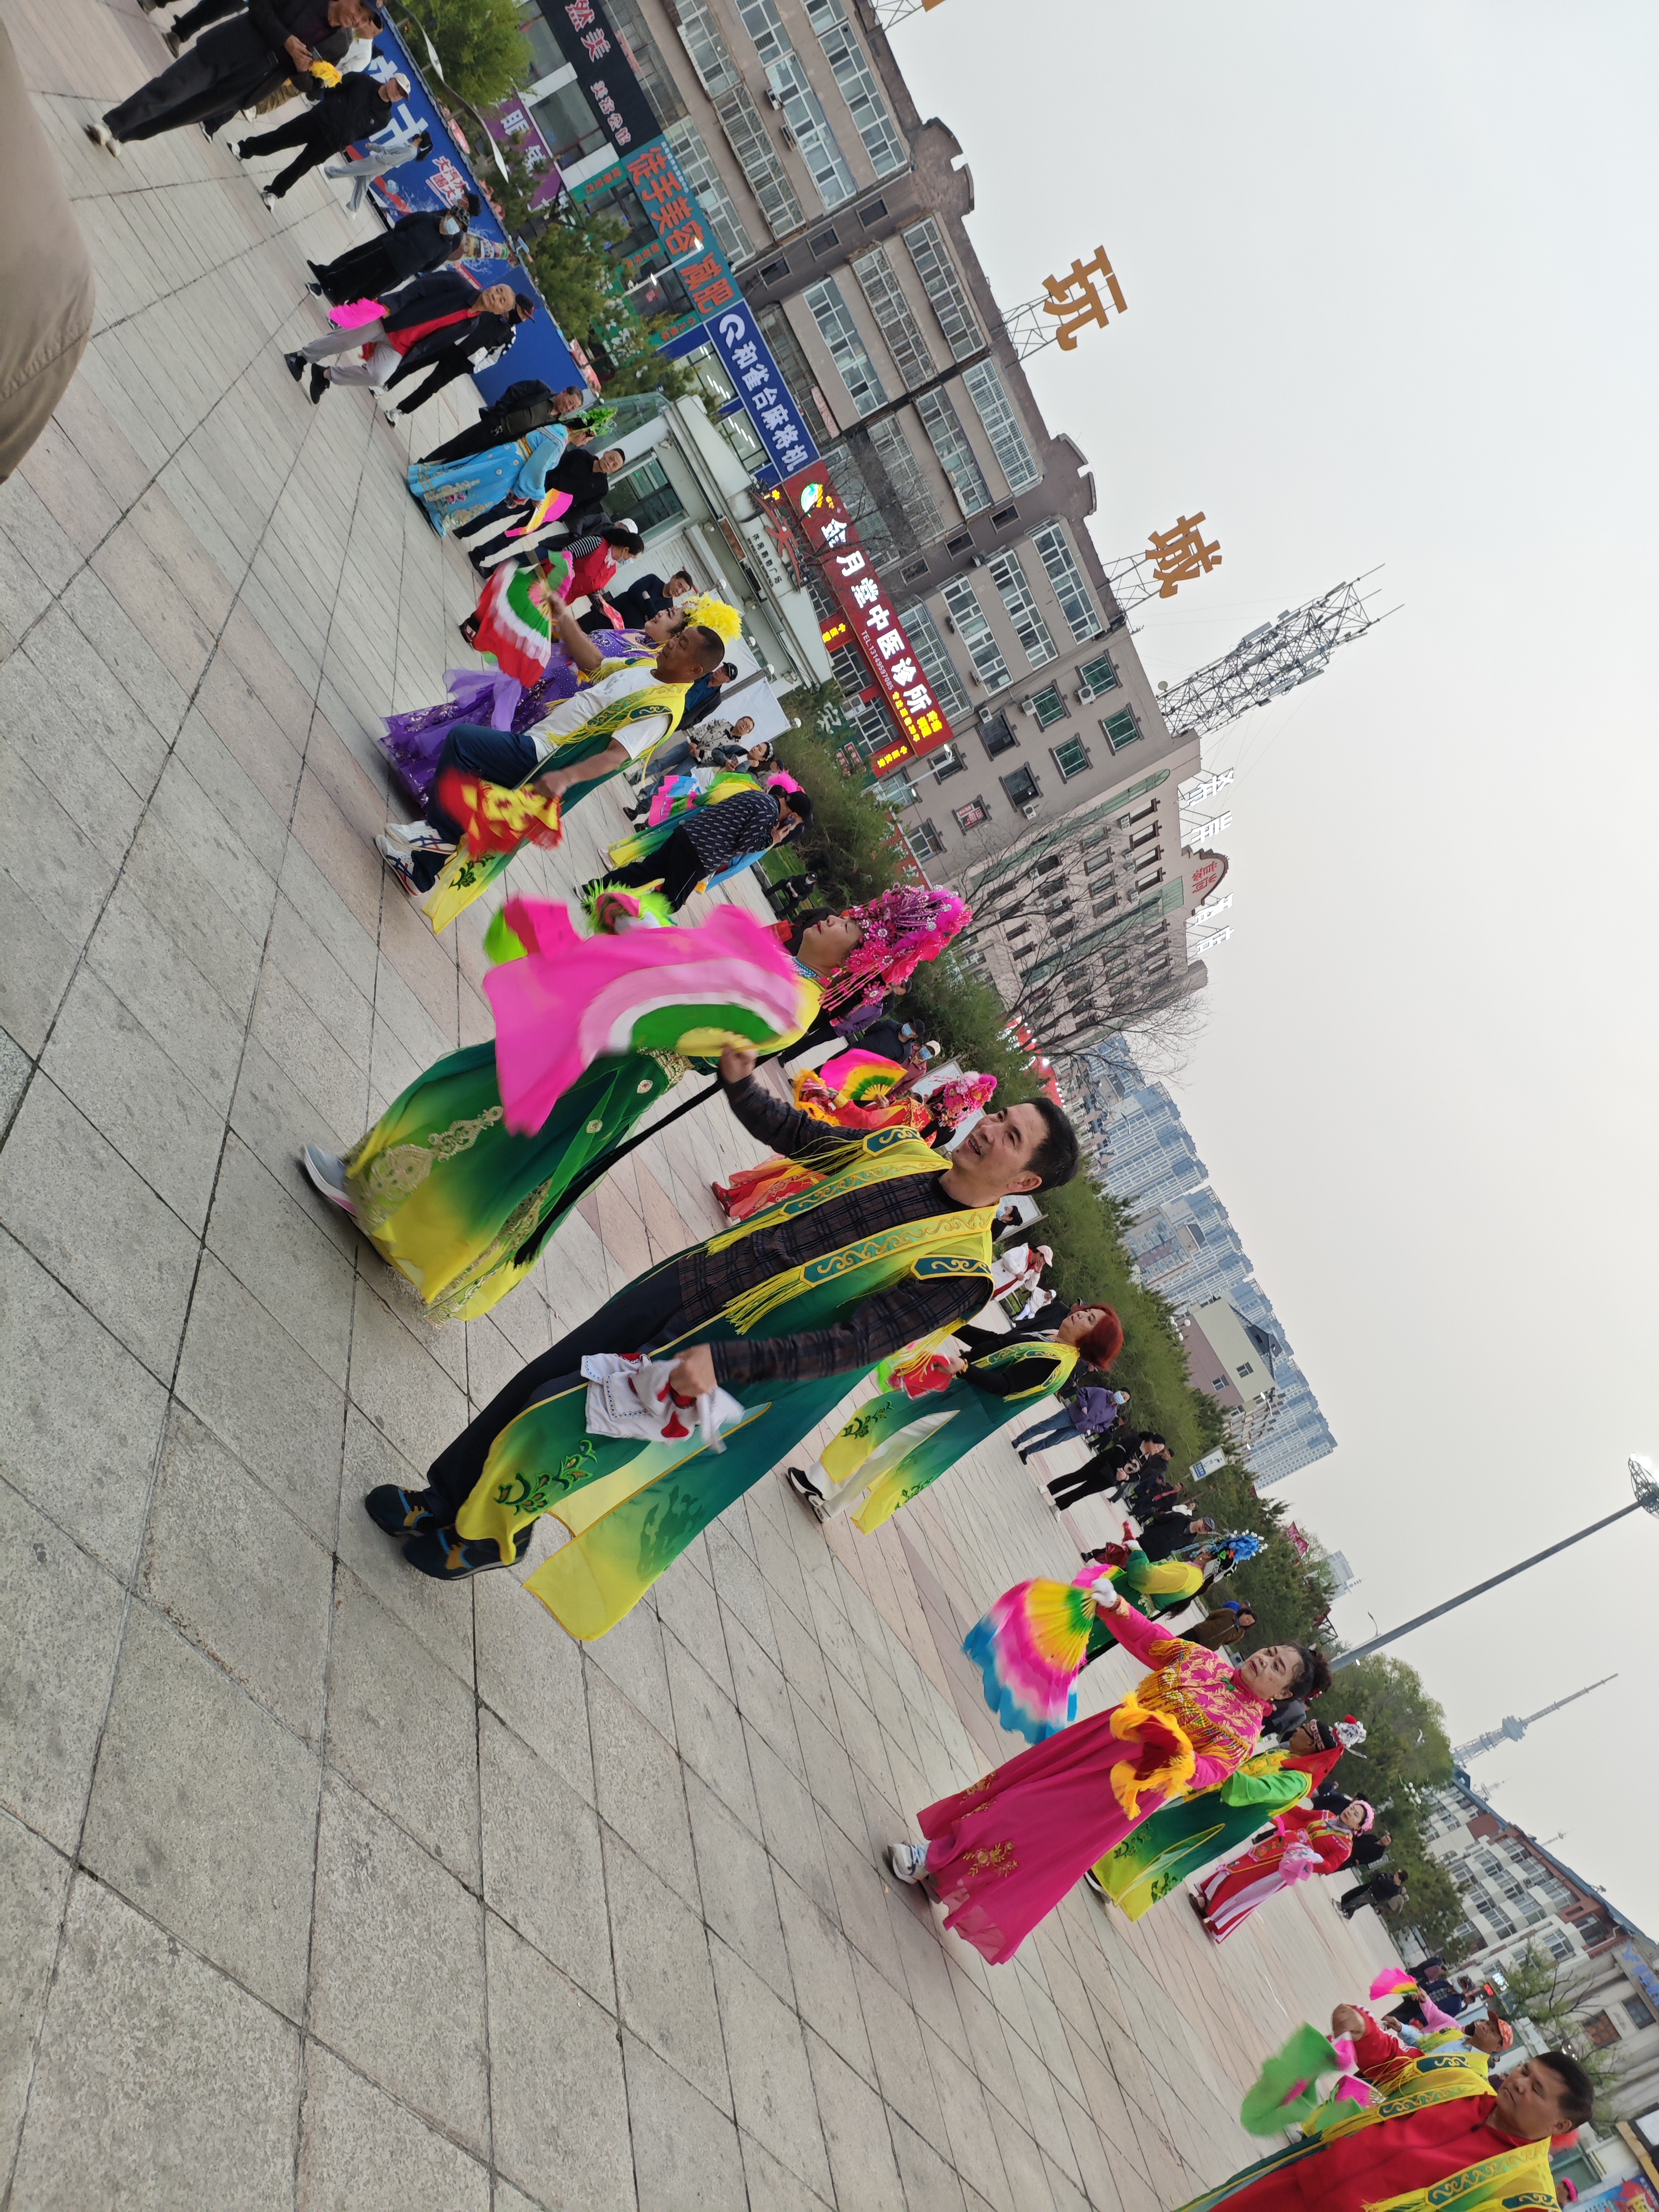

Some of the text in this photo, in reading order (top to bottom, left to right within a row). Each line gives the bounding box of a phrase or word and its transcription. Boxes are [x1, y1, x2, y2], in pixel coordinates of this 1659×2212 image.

[432, 172, 462, 206] 喝大
[728, 340, 812, 473] 和雀台麻将机
[751, 532, 783, 584] 休闲购物广场
[818, 514, 934, 716] 金月堂中医诊所
